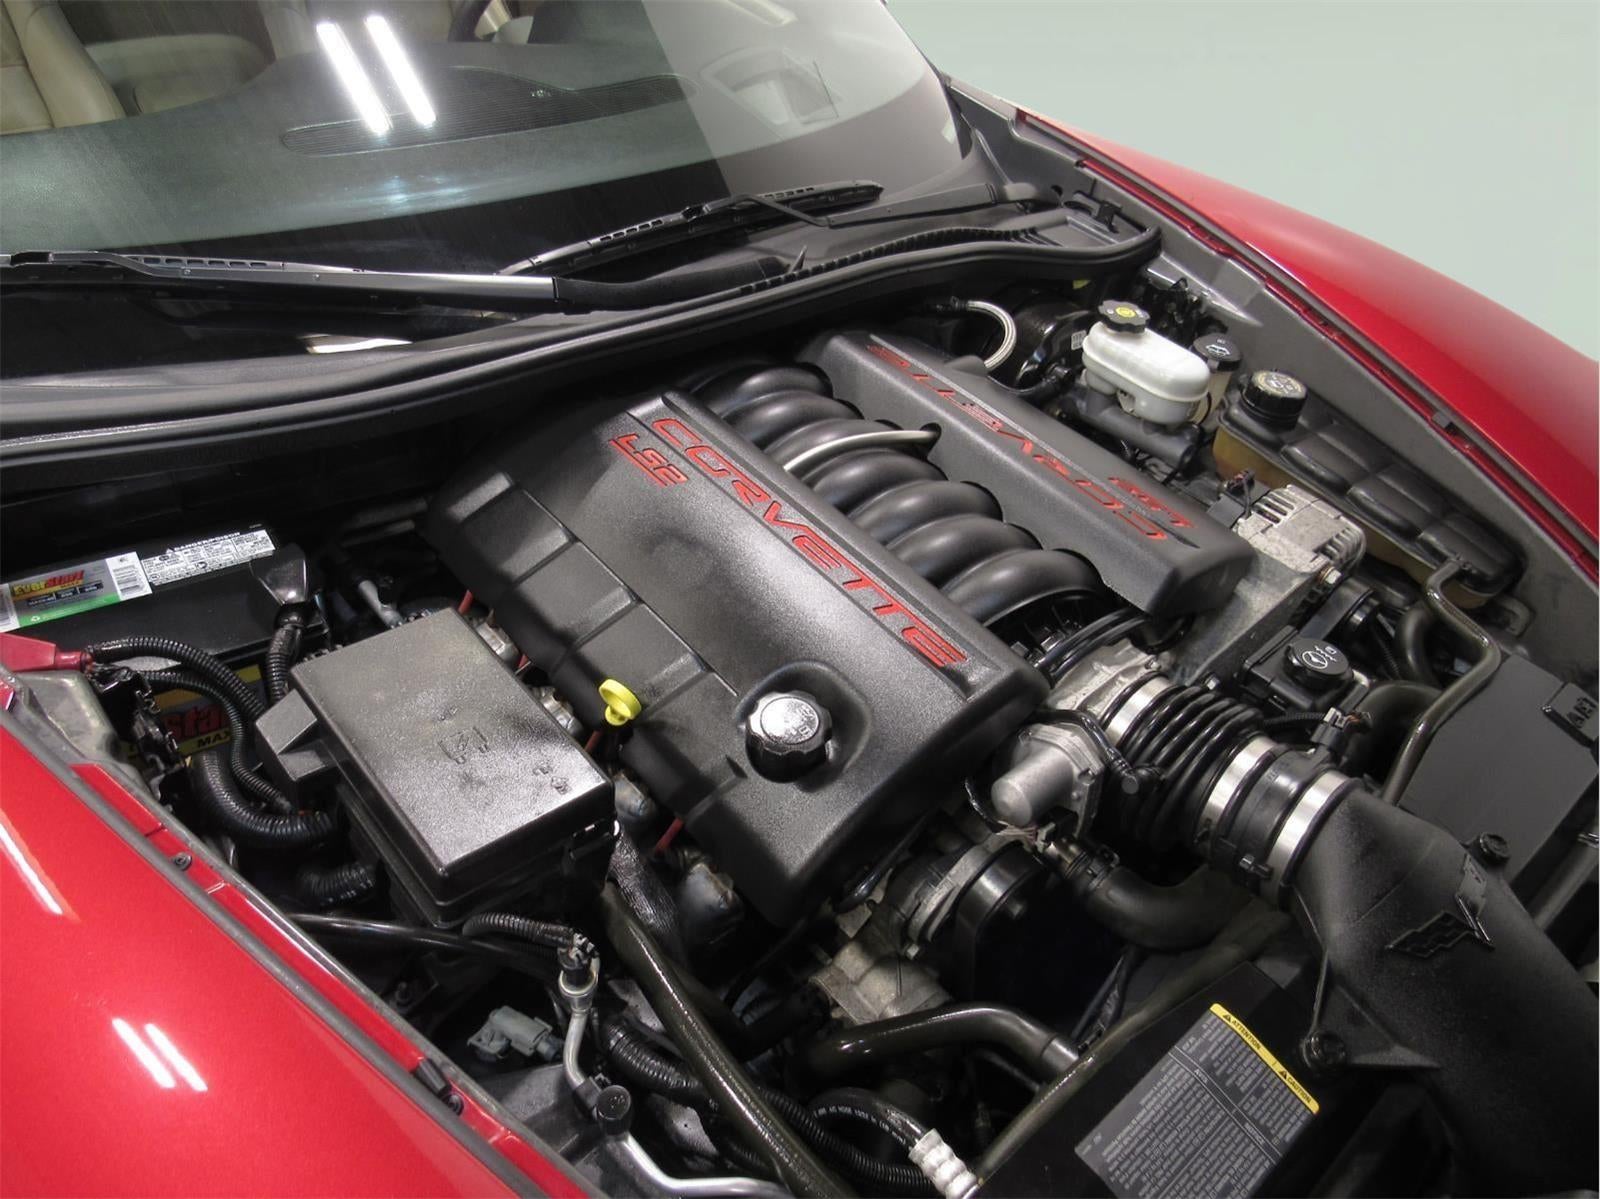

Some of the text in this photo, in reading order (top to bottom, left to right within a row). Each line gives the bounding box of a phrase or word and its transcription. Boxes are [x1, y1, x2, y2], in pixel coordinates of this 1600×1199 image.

[610, 433, 689, 487] LS2
[651, 418, 967, 667] CORVETTE
[1232, 1019, 1262, 1049] ATTENTION
[1286, 1076, 1311, 1104] CAUTION
